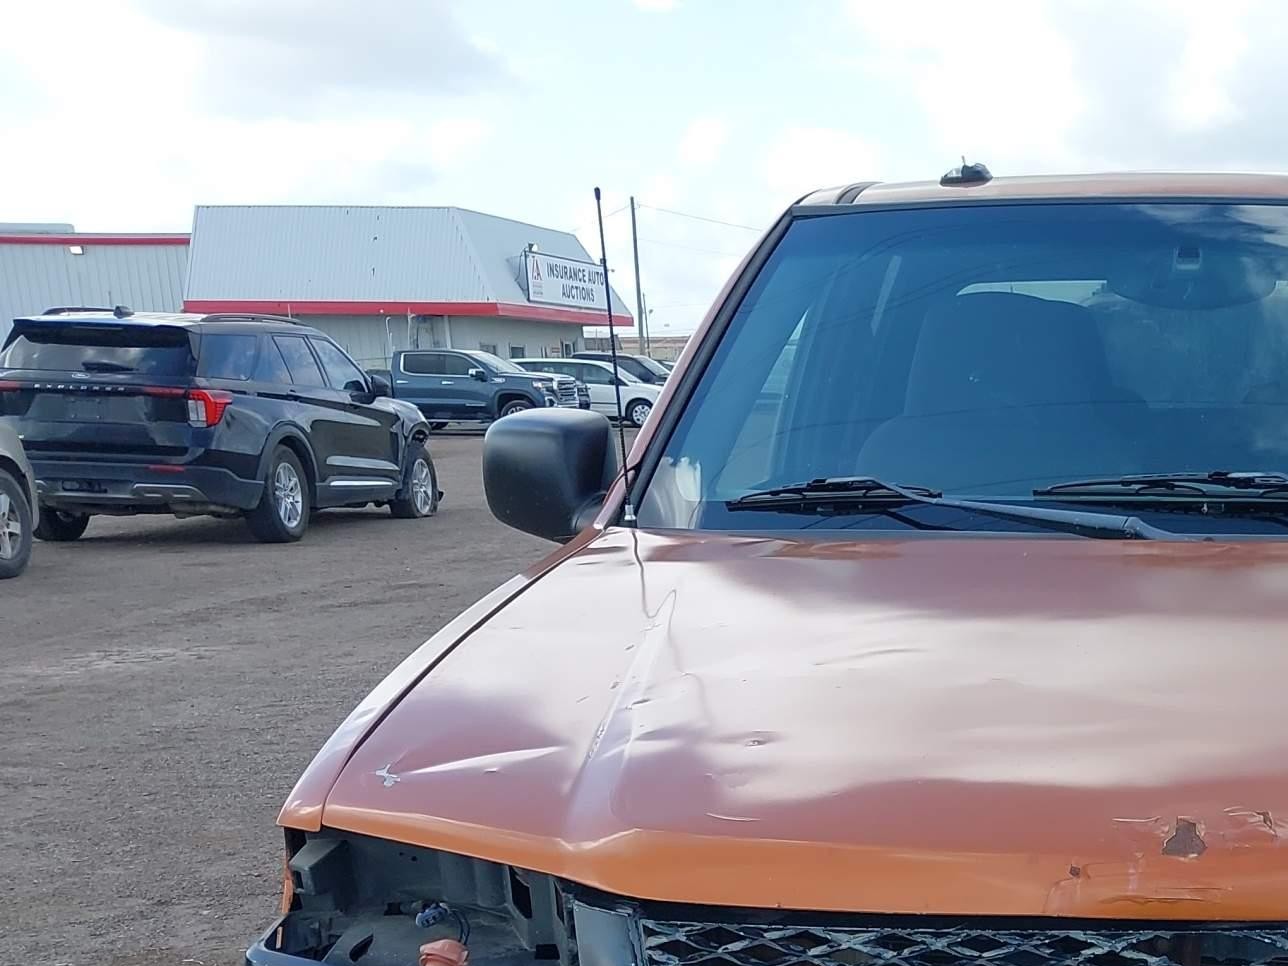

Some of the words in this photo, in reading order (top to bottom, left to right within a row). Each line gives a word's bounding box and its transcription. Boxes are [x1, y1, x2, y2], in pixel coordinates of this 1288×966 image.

[546, 262, 587, 283] INSURANCE
[587, 270, 605, 286] AUTO
[561, 283, 595, 302] AUCTIONS
